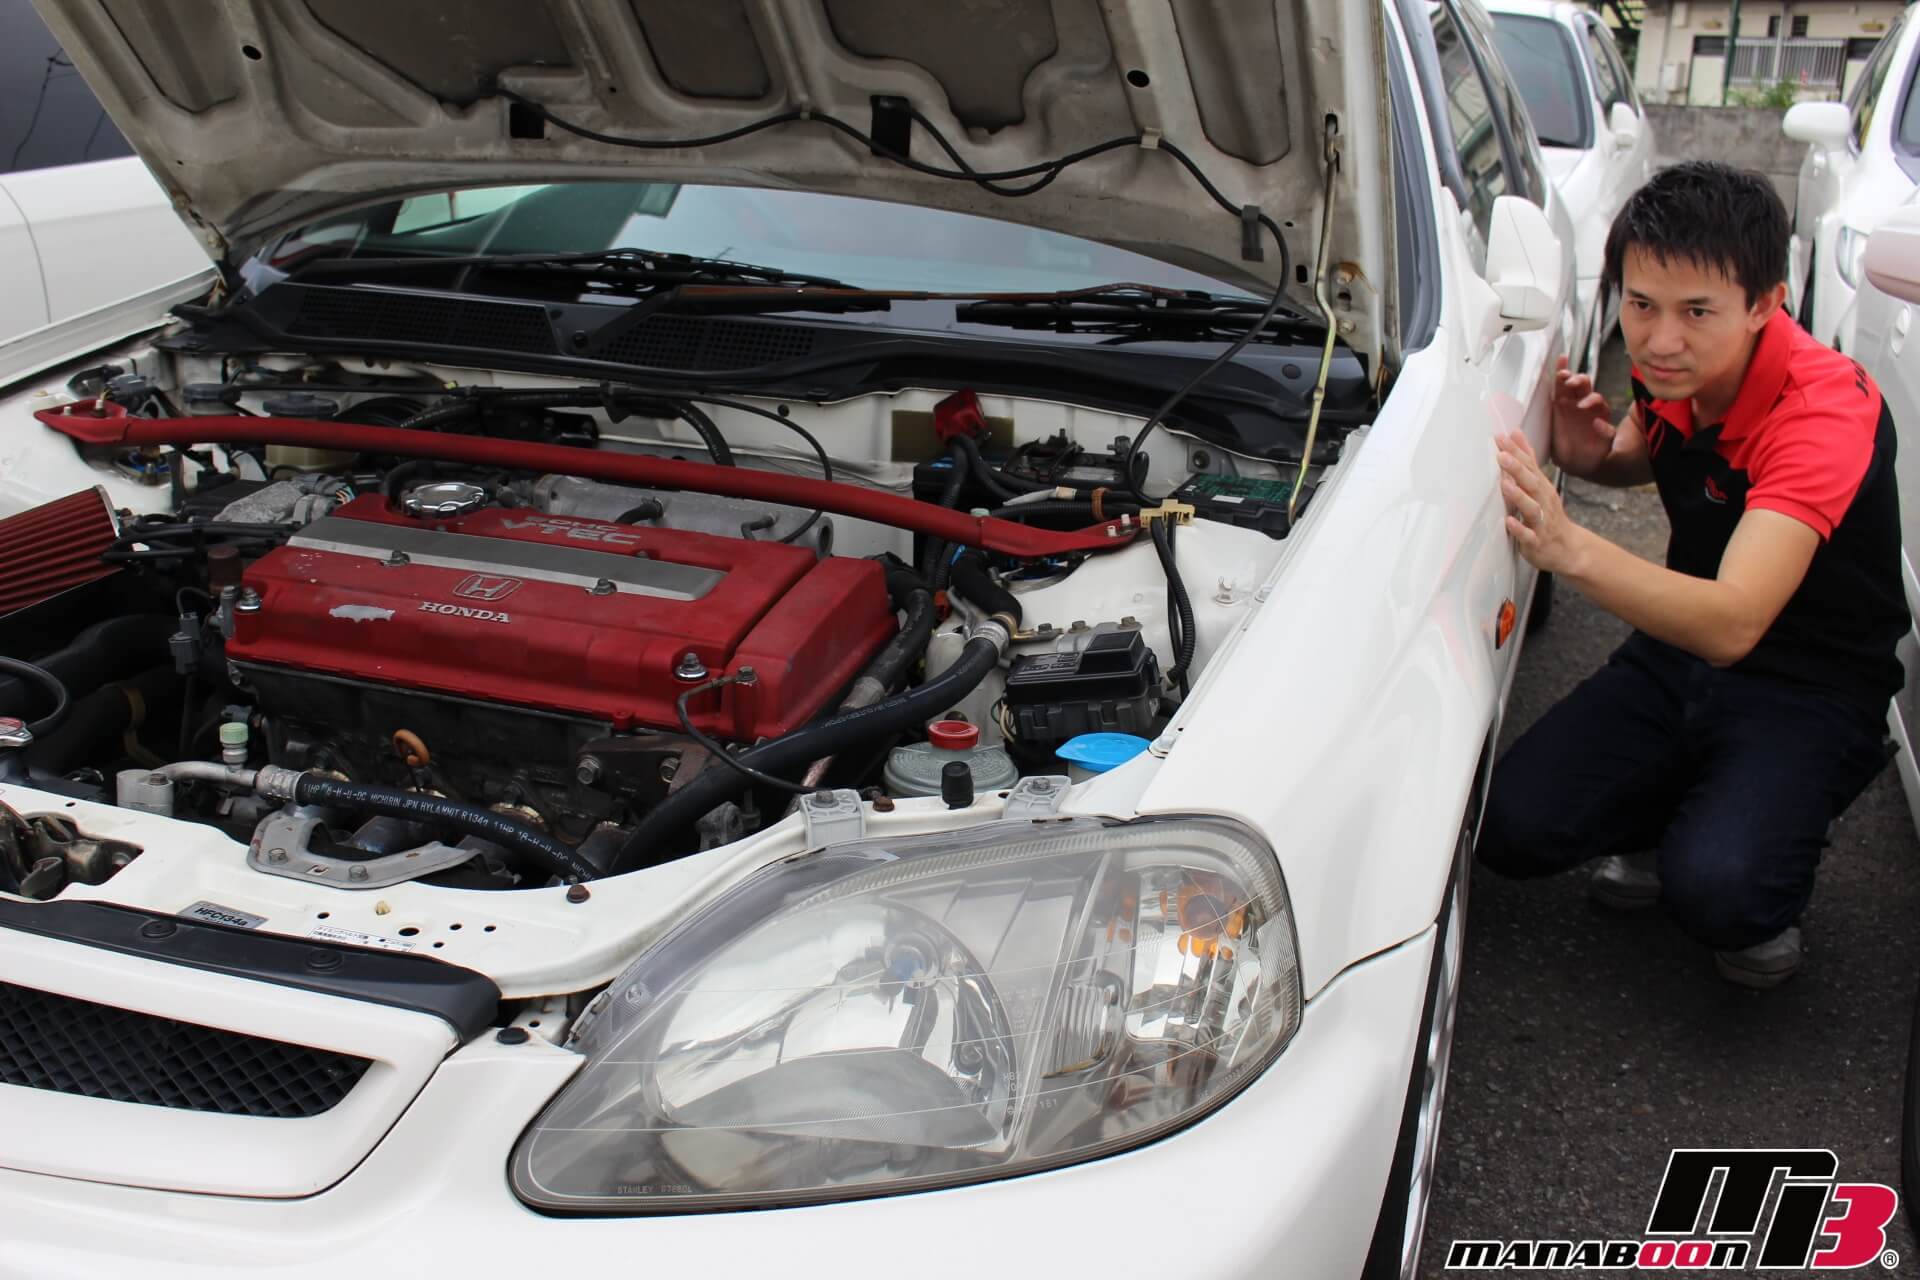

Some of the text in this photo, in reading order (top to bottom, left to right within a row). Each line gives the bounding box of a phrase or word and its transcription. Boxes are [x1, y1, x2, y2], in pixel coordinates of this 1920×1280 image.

[500, 517, 642, 546] VTEC
[418, 601, 511, 624] HONDA
[402, 799, 418, 809] JPN
[194, 907, 248, 927] HFC134a
